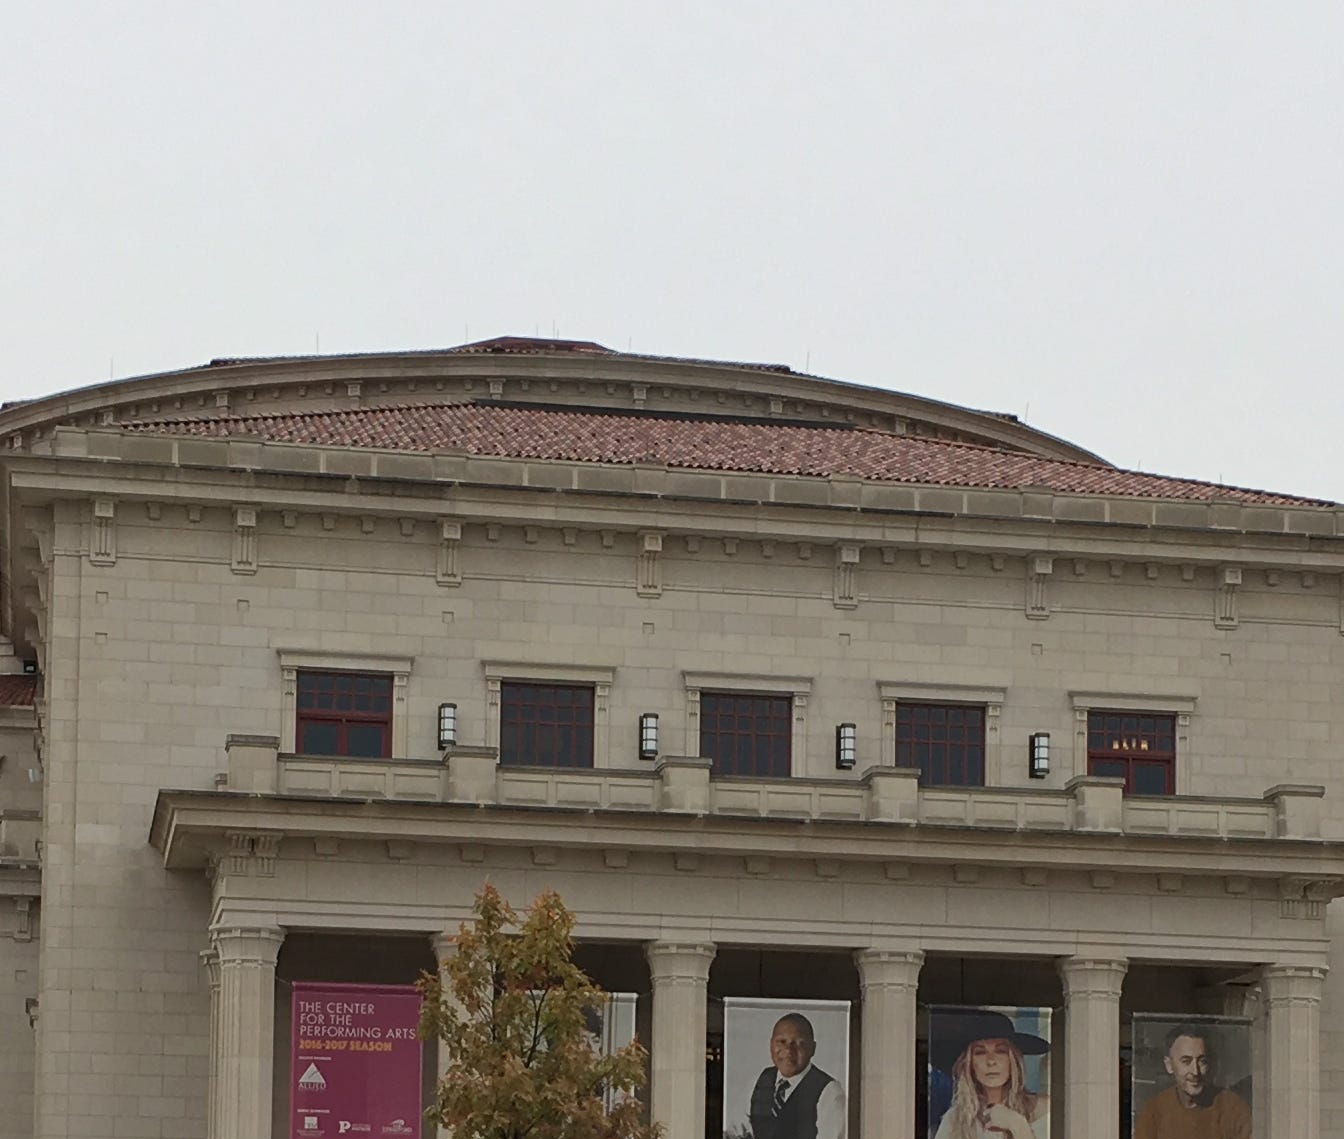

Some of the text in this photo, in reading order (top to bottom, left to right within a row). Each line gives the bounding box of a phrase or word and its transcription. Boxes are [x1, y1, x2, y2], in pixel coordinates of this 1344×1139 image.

[299, 1001, 375, 1015] THE CENTER
[299, 1013, 353, 1026] FOR THE
[299, 1025, 416, 1040] PERFORMING ARTS
[298, 1039, 393, 1052] 2016-2017 SEASON
